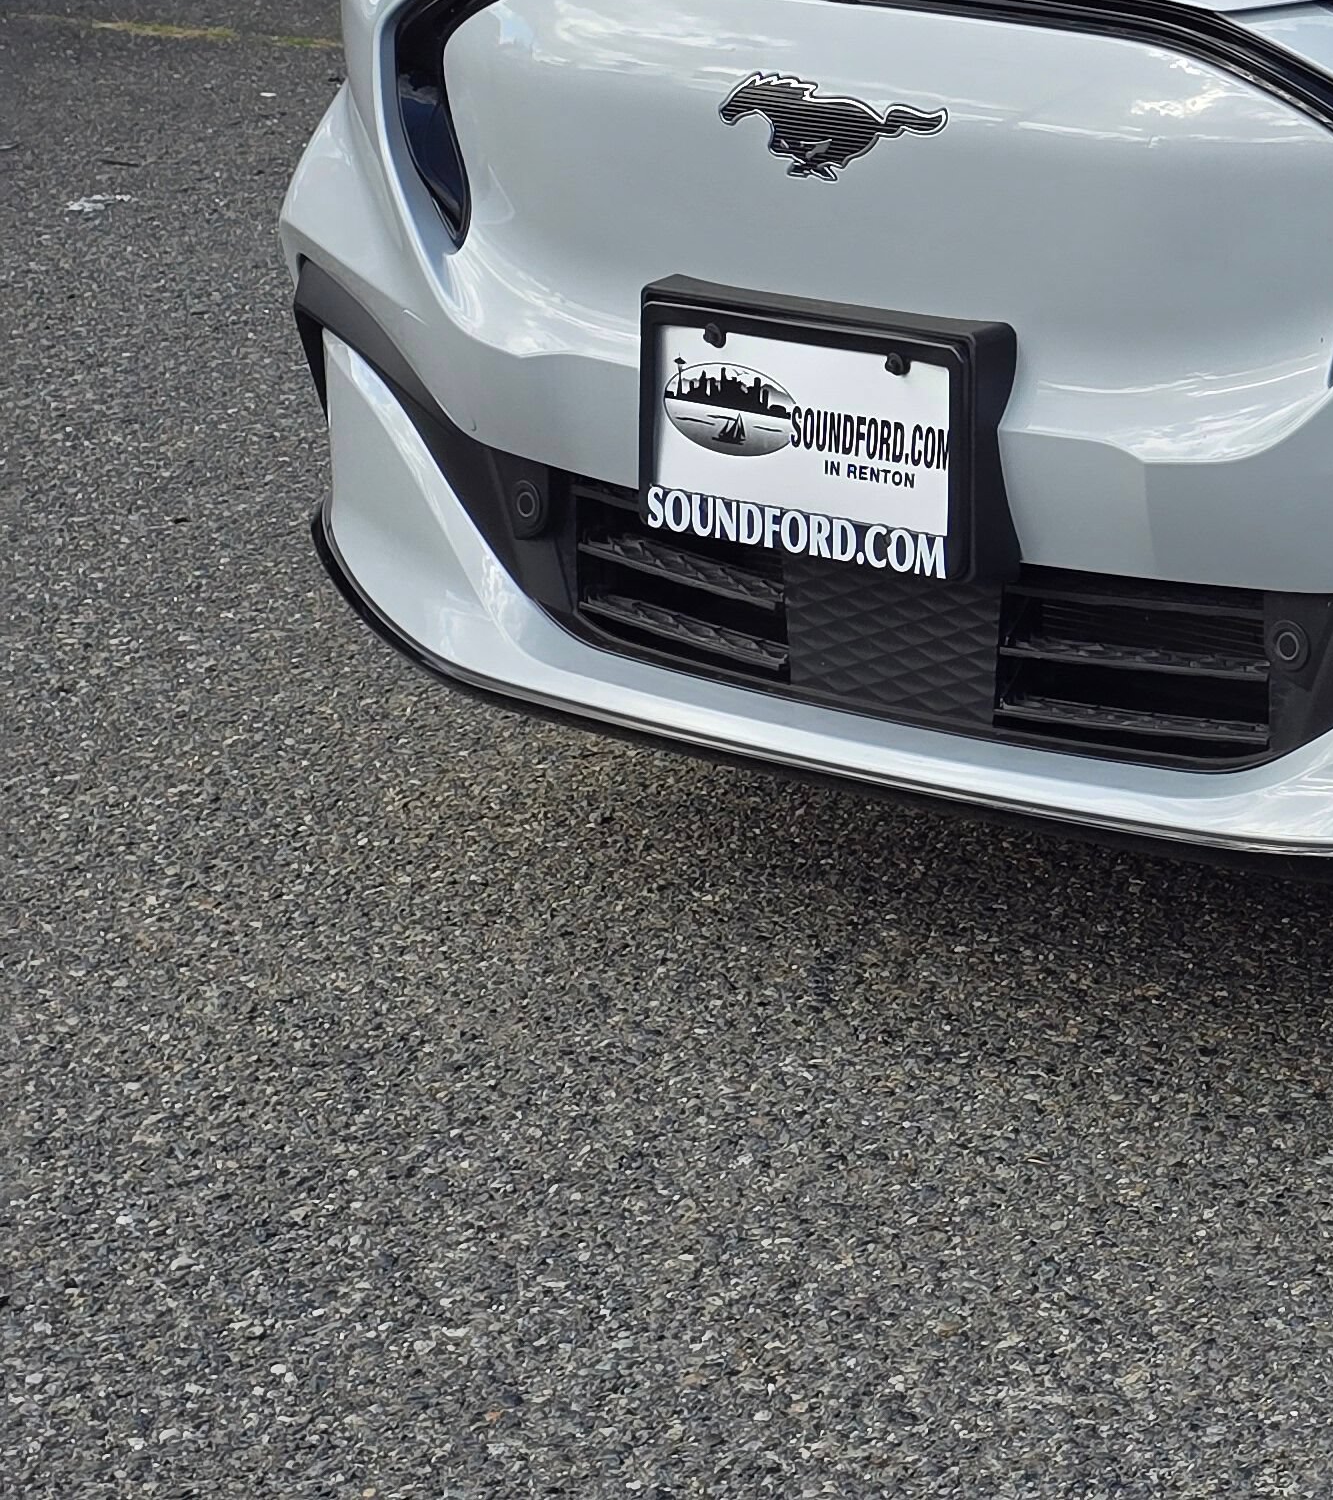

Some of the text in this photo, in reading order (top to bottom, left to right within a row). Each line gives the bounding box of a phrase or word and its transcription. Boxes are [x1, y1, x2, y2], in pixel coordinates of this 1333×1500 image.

[790, 405, 949, 472] SOUNDFORD.COM
[823, 459, 916, 489] IN RENTON
[647, 485, 947, 580] SOUNDFORD.COM
